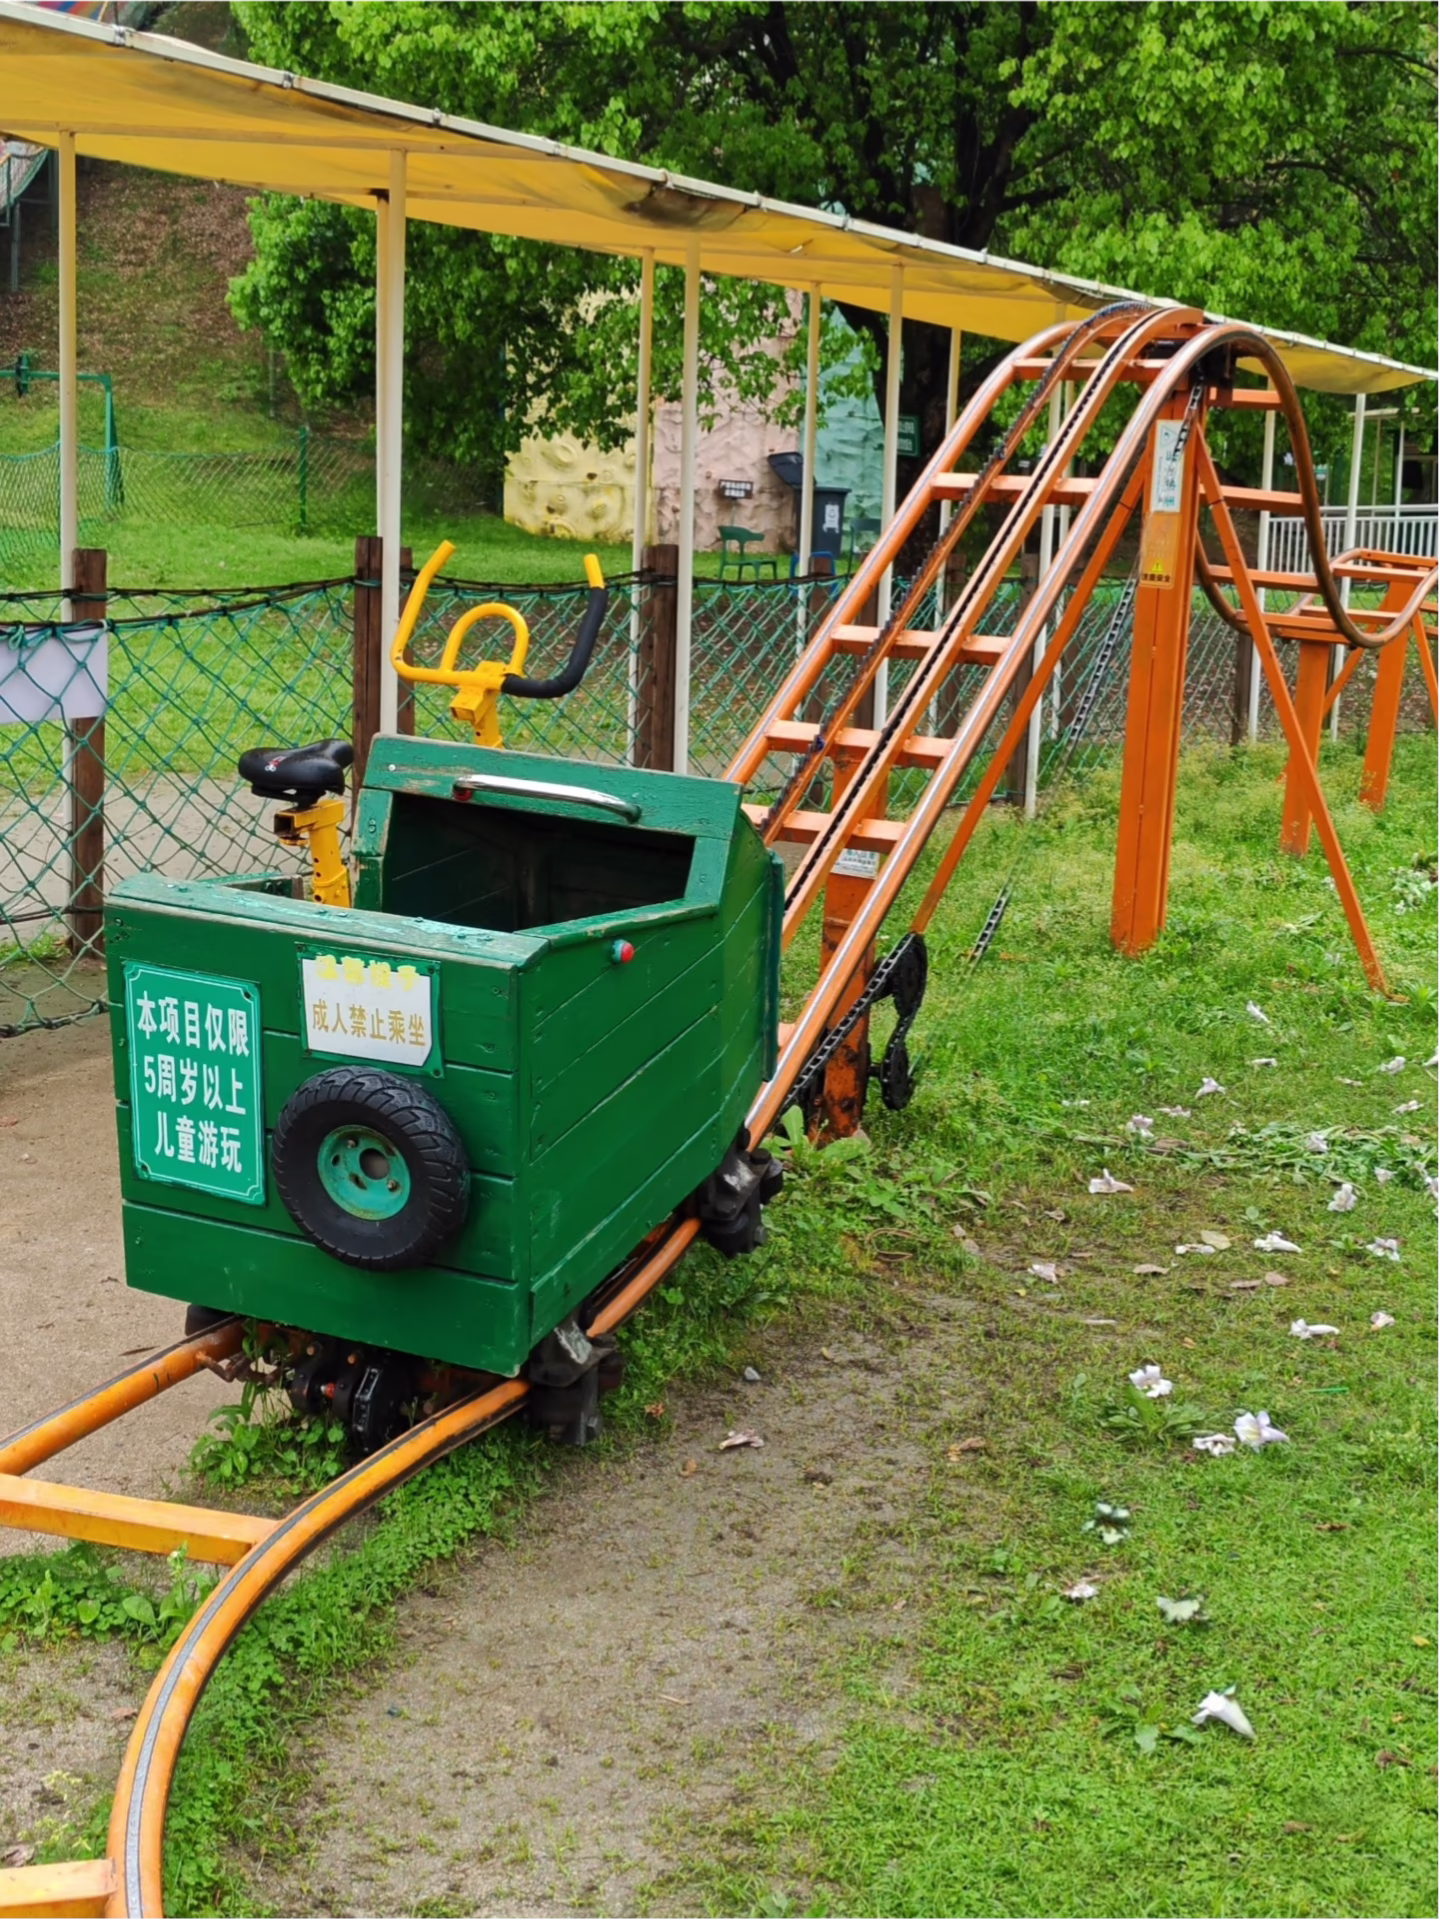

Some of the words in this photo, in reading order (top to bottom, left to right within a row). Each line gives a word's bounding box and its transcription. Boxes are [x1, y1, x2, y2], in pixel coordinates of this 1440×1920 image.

[136, 990, 250, 1057] 本项目仅限
[312, 998, 426, 1047] 成人禁止乘坐
[144, 1053, 246, 1115] 5周岁以上
[154, 1111, 242, 1173] 儿童游玩
